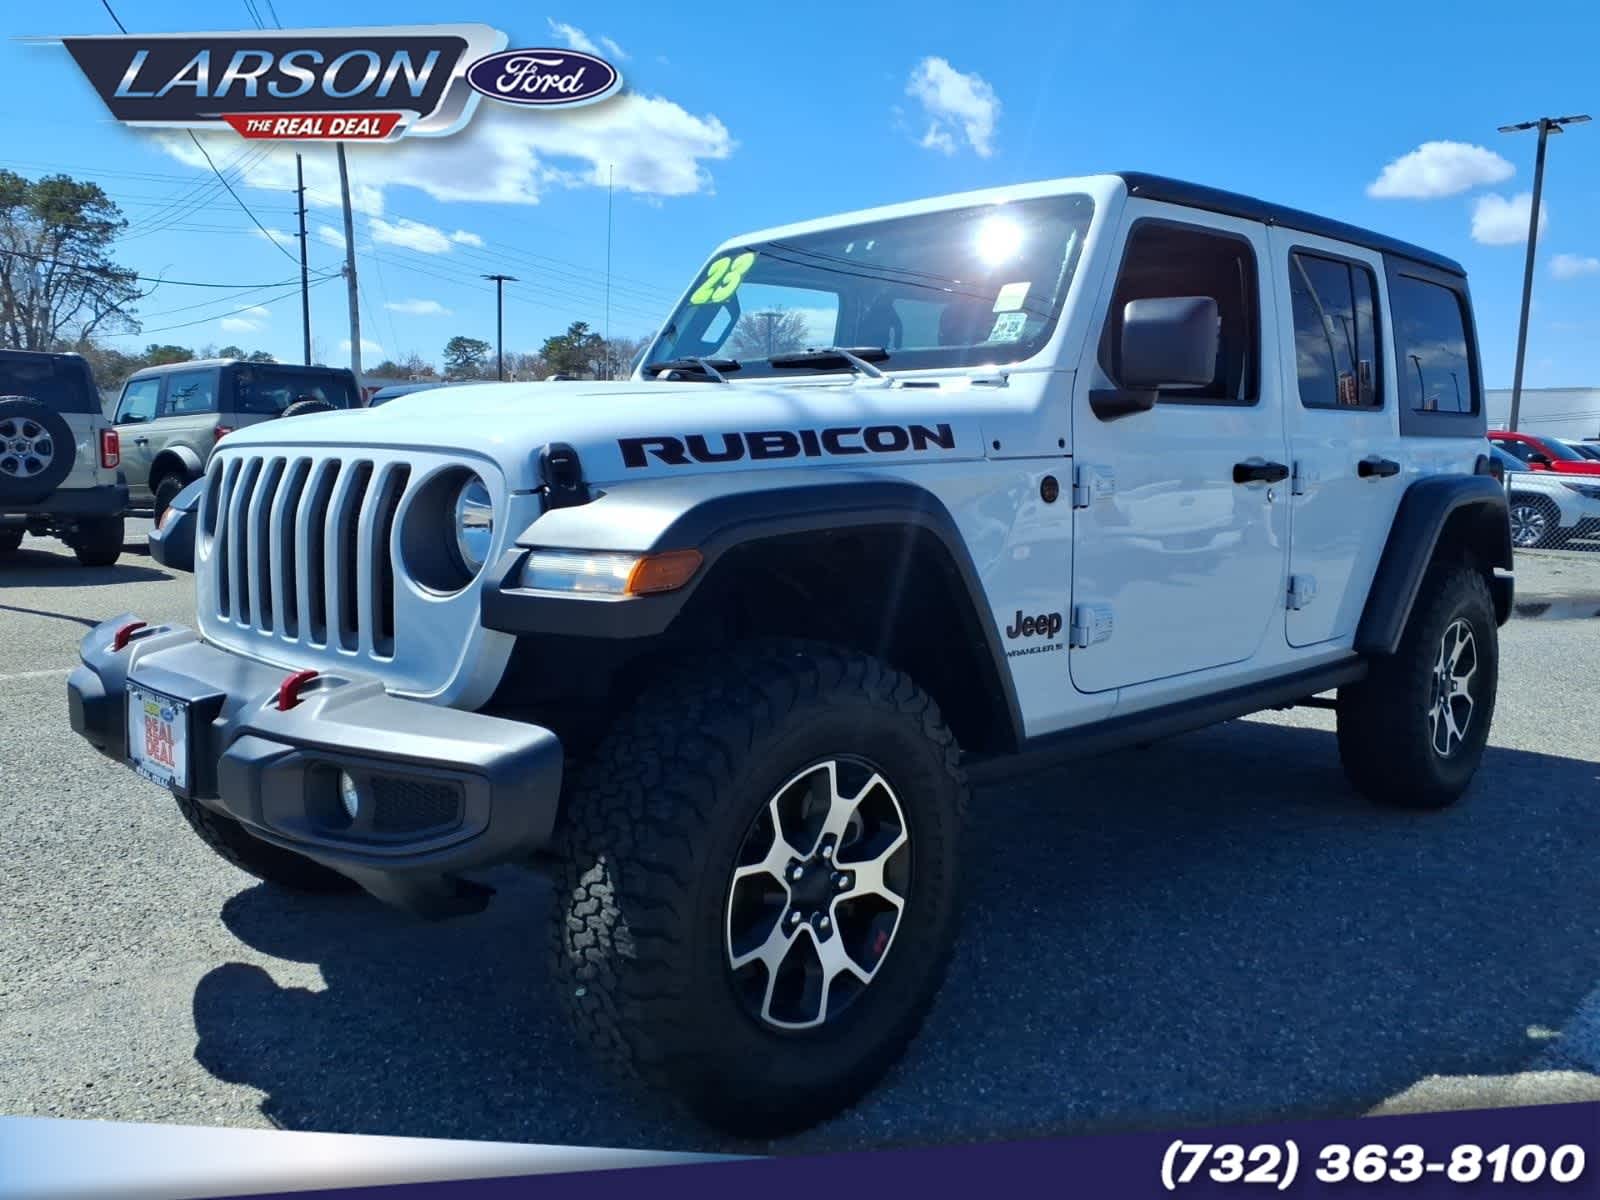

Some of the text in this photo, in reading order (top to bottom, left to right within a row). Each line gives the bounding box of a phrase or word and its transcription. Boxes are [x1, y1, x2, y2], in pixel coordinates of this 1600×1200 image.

[690, 252, 755, 304] 23
[617, 423, 956, 469] RUBICON
[1006, 610, 1063, 639] Jeep
[1006, 643, 1055, 657] WRANGLER
[145, 716, 175, 743] REAL
[146, 737, 175, 767] DEAL
